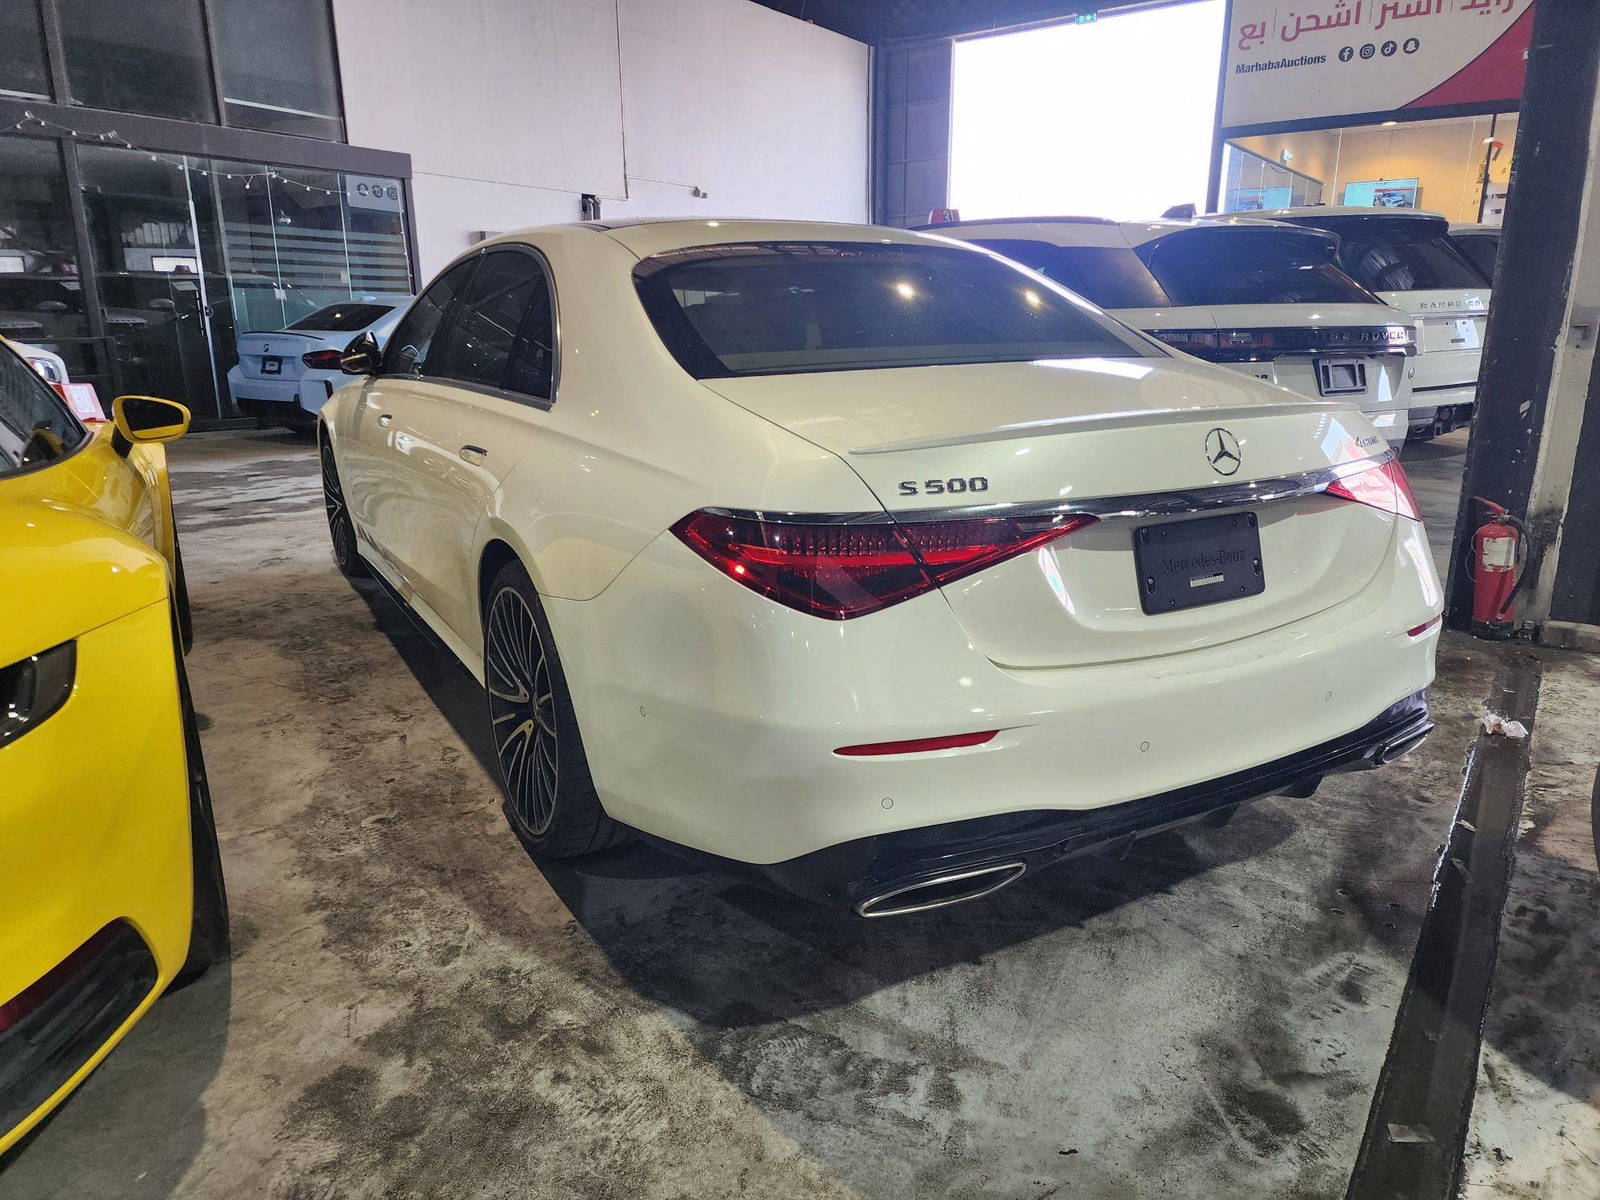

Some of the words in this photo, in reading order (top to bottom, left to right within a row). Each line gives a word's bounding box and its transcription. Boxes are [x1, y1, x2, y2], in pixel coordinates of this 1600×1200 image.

[1281, 0, 1361, 42] اشحن
[1238, 22, 1266, 51] بع
[1236, 54, 1327, 74] MarhabaAuctions
[898, 480, 919, 496] S
[925, 476, 989, 495] 500
[1162, 551, 1246, 575] Mercedes-Benz
